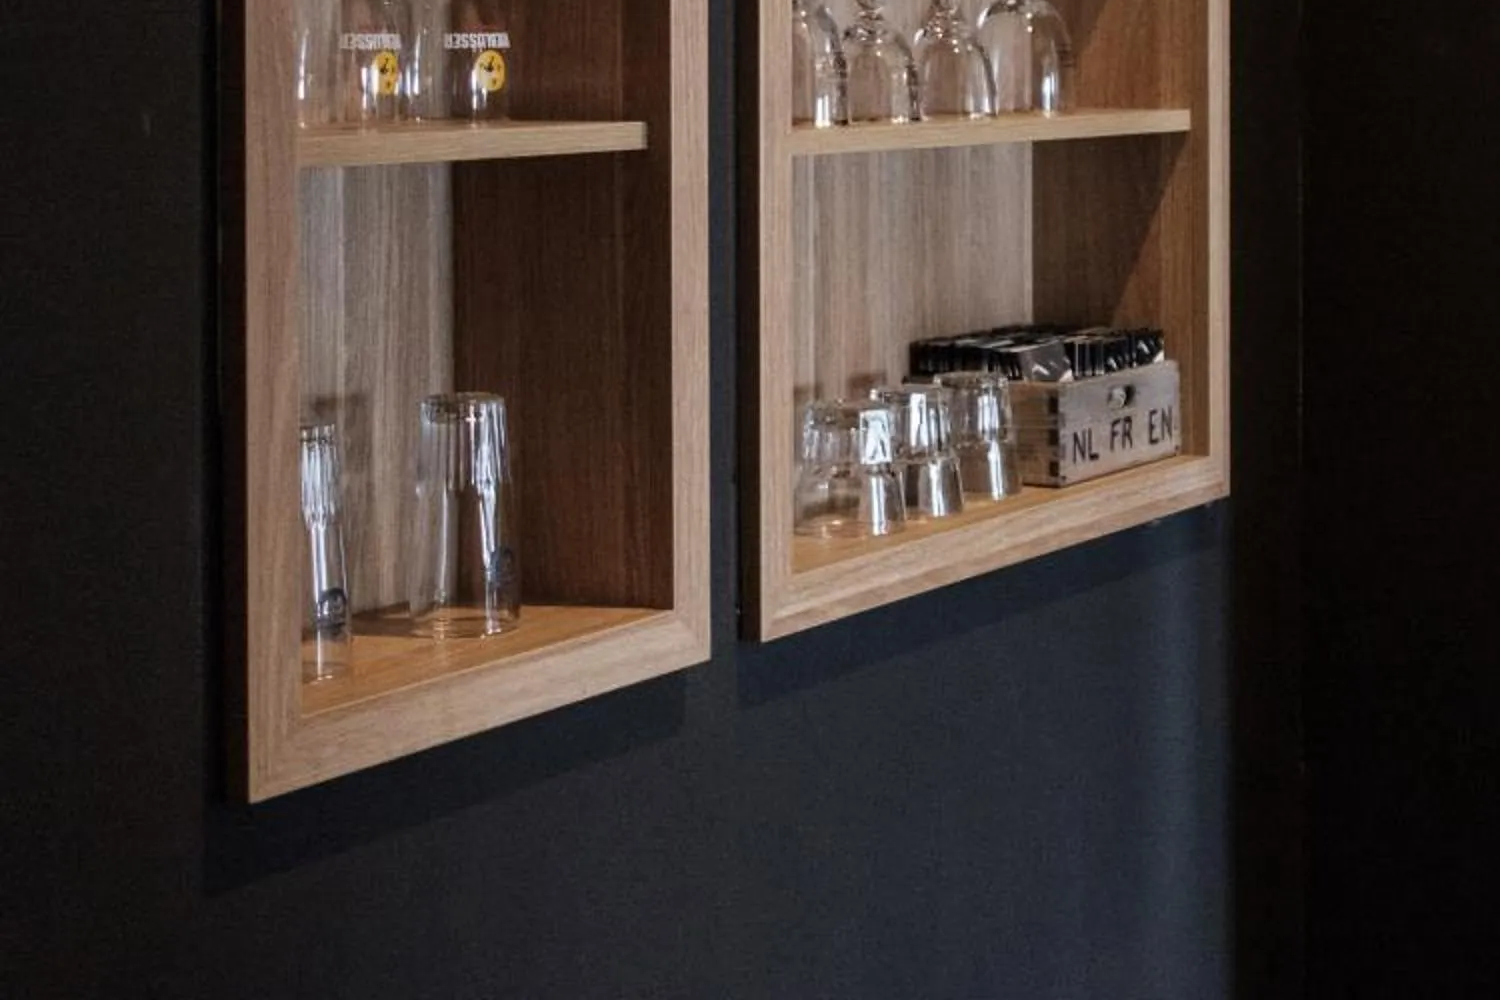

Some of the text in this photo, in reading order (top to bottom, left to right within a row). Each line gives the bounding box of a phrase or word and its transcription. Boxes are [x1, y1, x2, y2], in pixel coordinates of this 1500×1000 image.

[1071, 404, 1174, 464] NL FR EN
